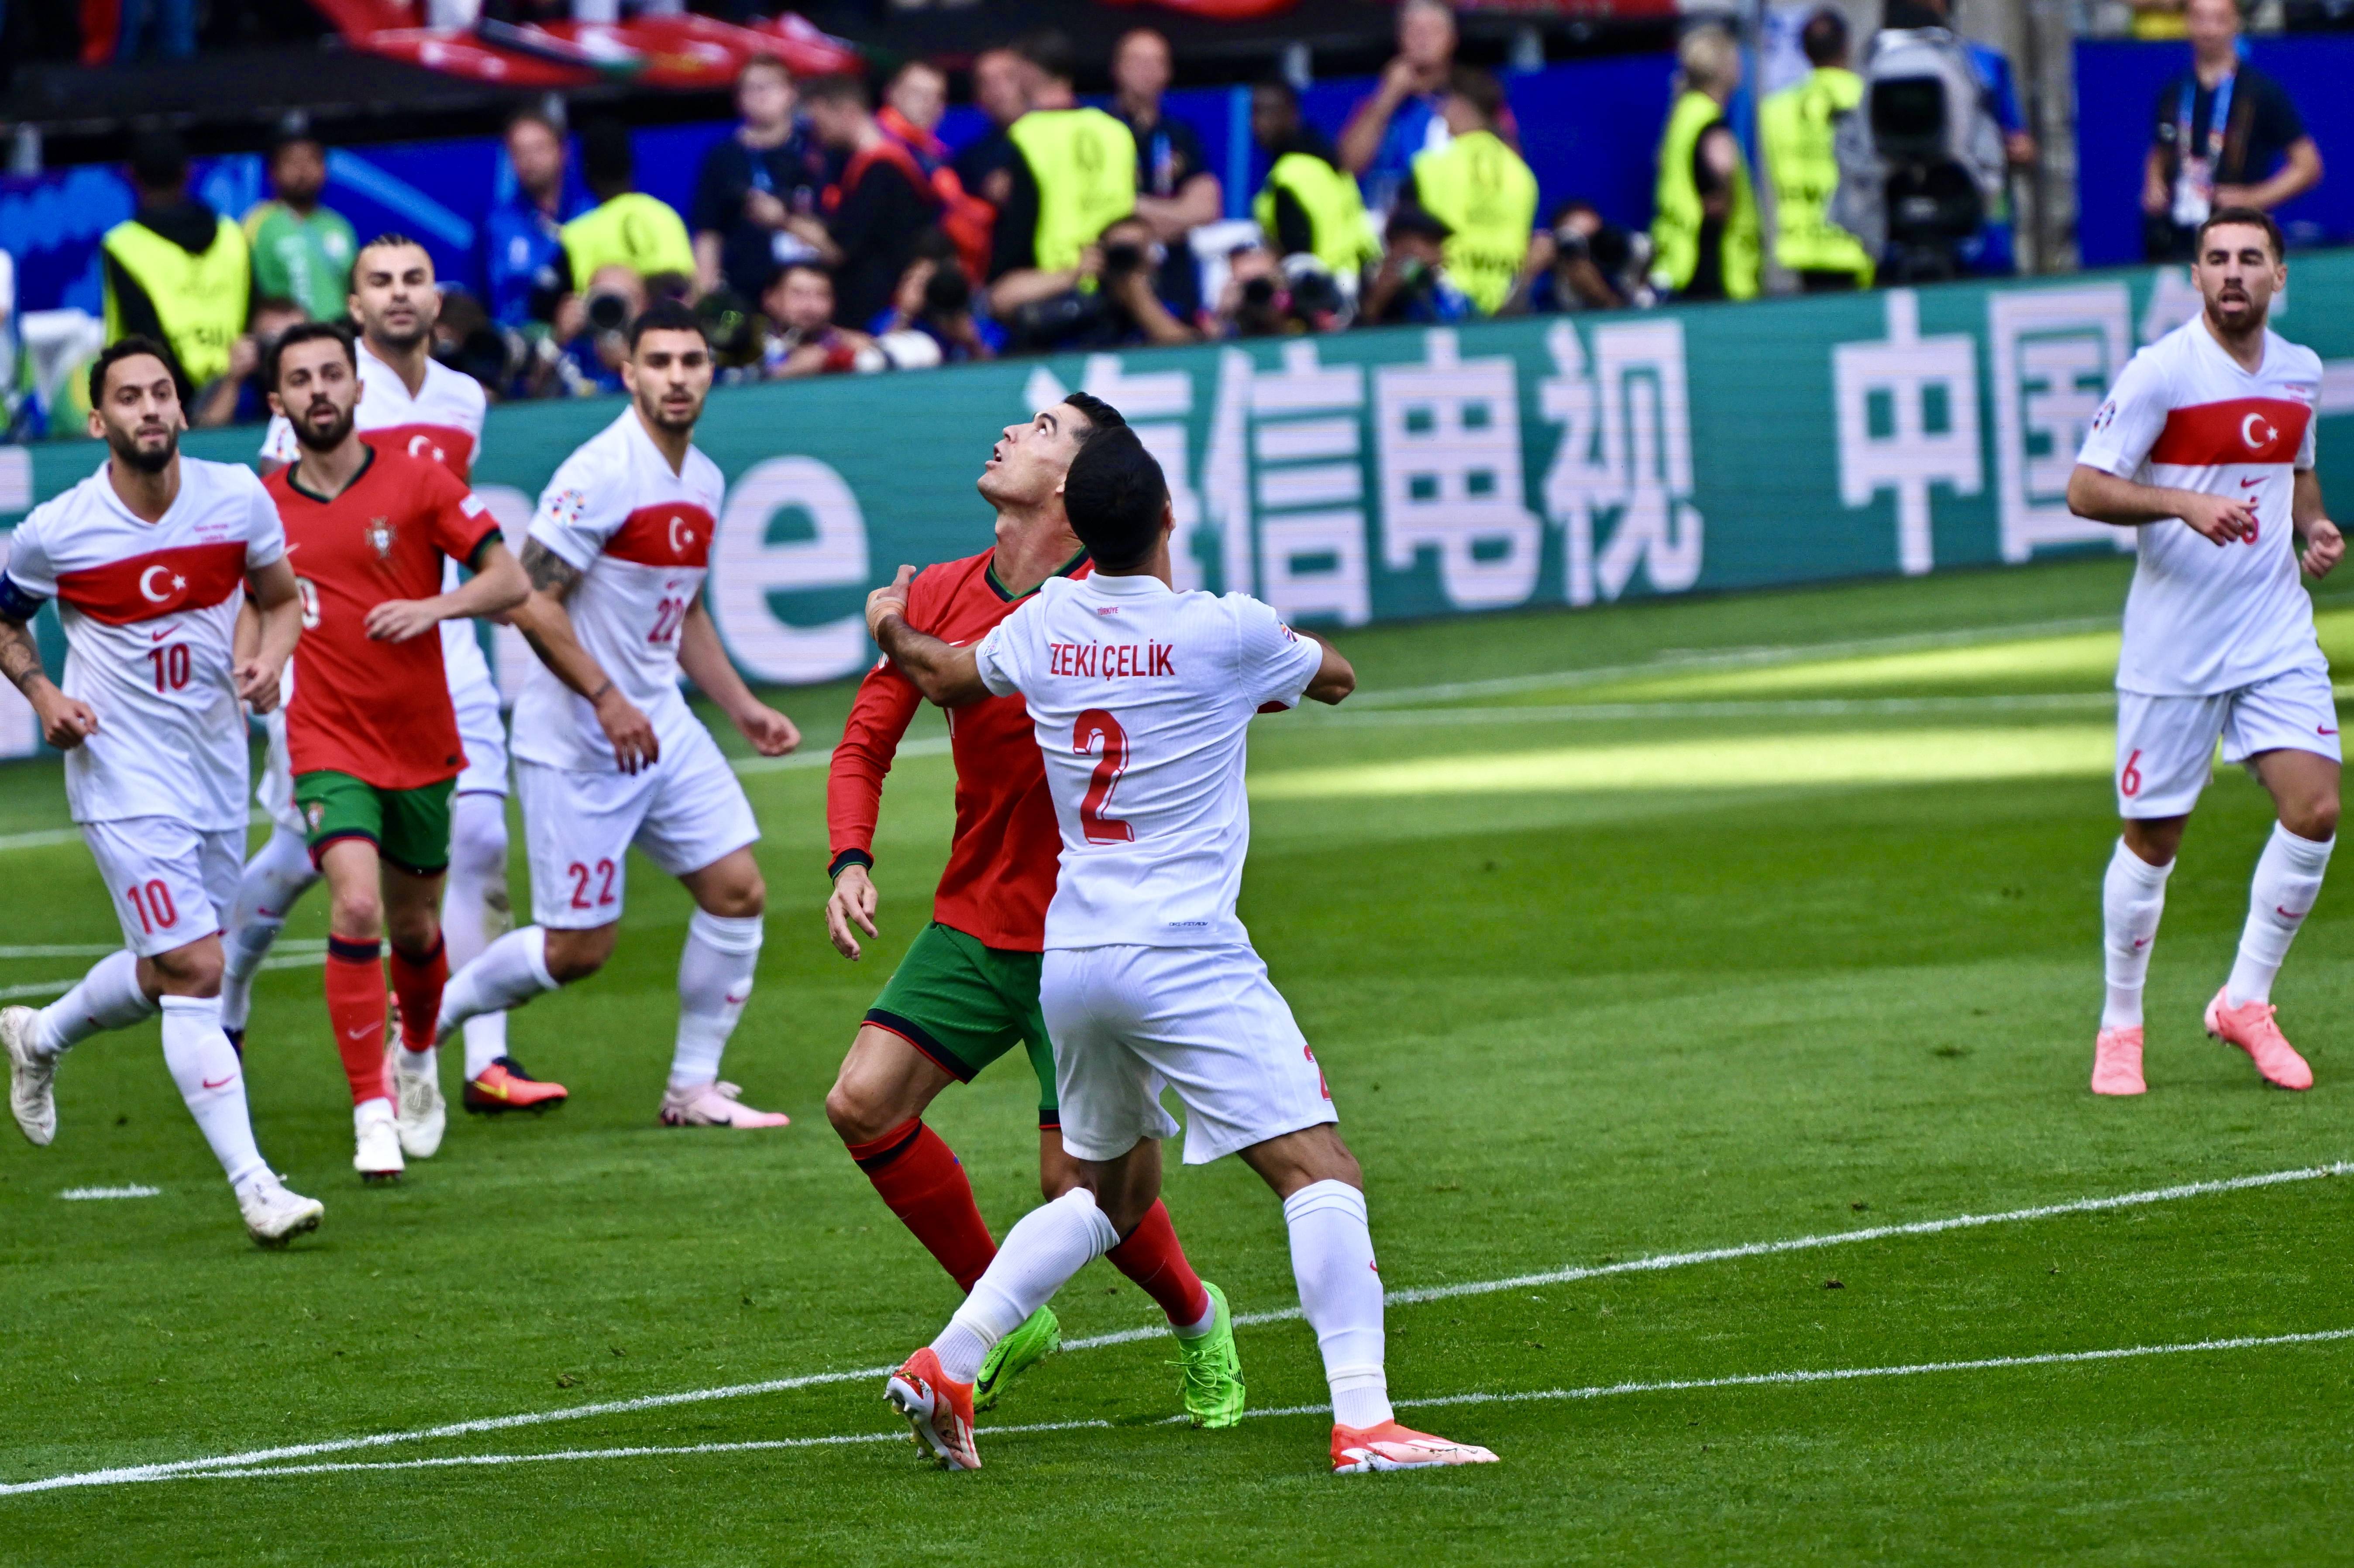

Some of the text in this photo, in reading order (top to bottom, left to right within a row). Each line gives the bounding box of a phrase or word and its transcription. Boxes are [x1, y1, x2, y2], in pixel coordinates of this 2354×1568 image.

[647, 598, 684, 643] 22
[148, 643, 191, 694] 10
[1050, 639, 1175, 681] ZEKİ ÇELİK
[1073, 708, 1135, 845] 2
[2121, 749, 2141, 798] 6
[127, 879, 179, 935] 10
[569, 858, 615, 909] 22
